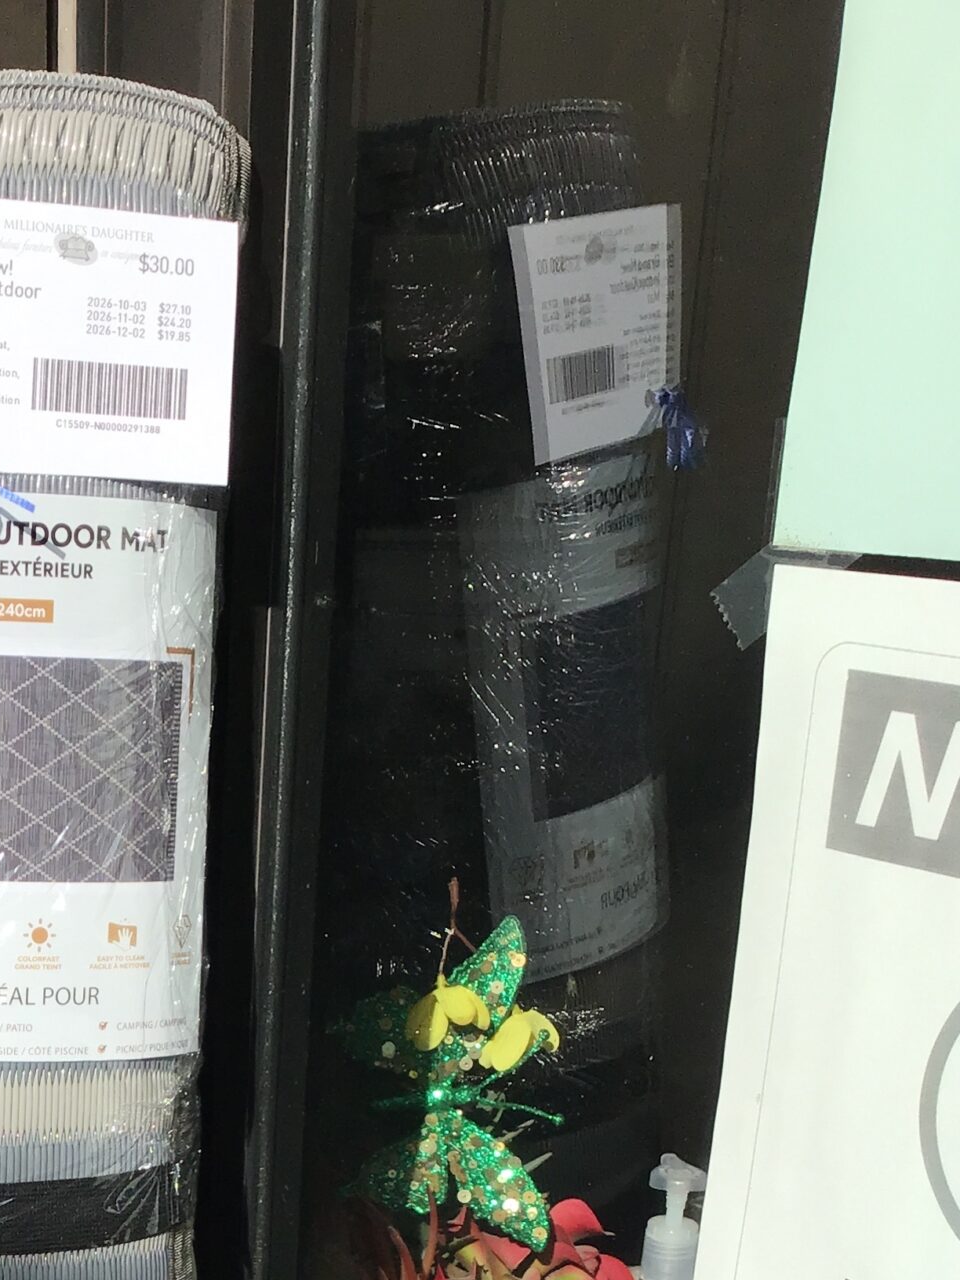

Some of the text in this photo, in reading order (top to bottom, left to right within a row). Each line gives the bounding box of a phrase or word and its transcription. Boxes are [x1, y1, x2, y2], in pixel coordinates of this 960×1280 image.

[4, 219, 88, 236] MILLIONAIRE'S
[91, 226, 155, 243] DAUGHTER
[138, 252, 195, 277] $30.00
[87, 296, 192, 316] 2026-10-03 $27.10
[86, 309, 192, 329] 2026-11-02 $24.20
[86, 323, 191, 343] 2026-12-02 $19.85
[121, 526, 168, 553] MAT
[0, 556, 93, 579] EXTÉRIEUR
[42, 986, 100, 1006] POUR
[6, 1023, 33, 1033] PATIO
[116, 1020, 153, 1031] CAMPING
[28, 1045, 52, 1056] CÔTÉ
[54, 1046, 89, 1056] PISCINE
[116, 1044, 143, 1054] PICNIC
